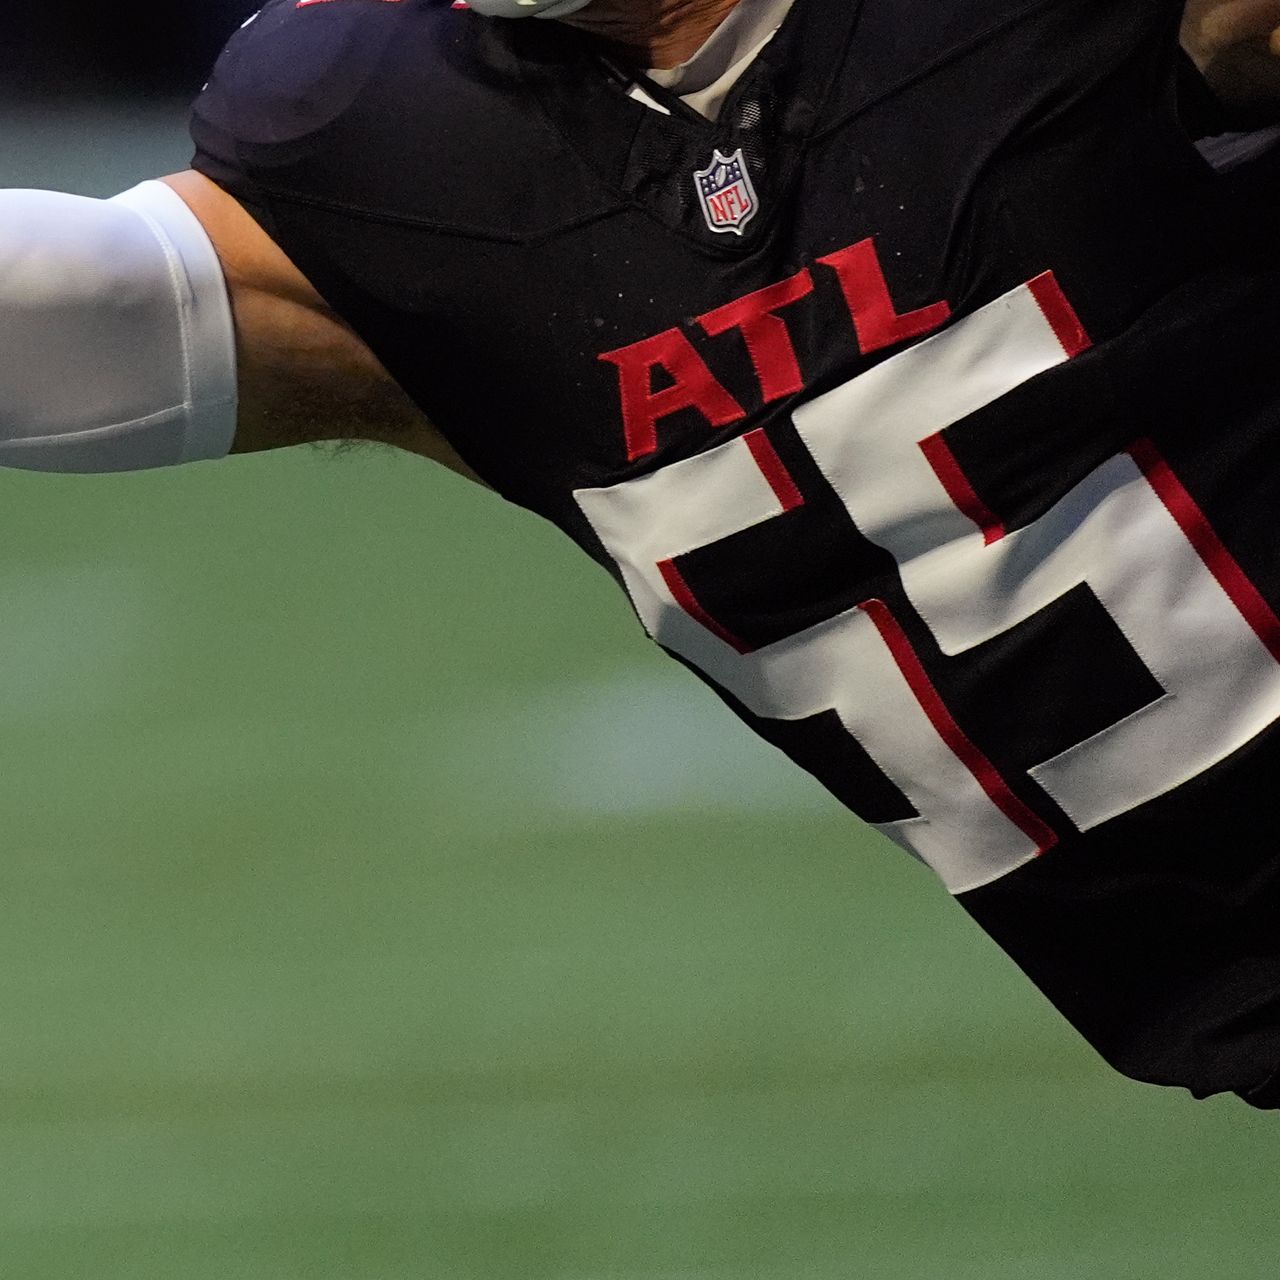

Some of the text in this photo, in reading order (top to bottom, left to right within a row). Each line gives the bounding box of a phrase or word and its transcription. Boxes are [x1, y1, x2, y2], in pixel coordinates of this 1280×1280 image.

[709, 184, 750, 223] NFL
[597, 237, 951, 463] ATL
[572, 270, 1280, 895] 55
